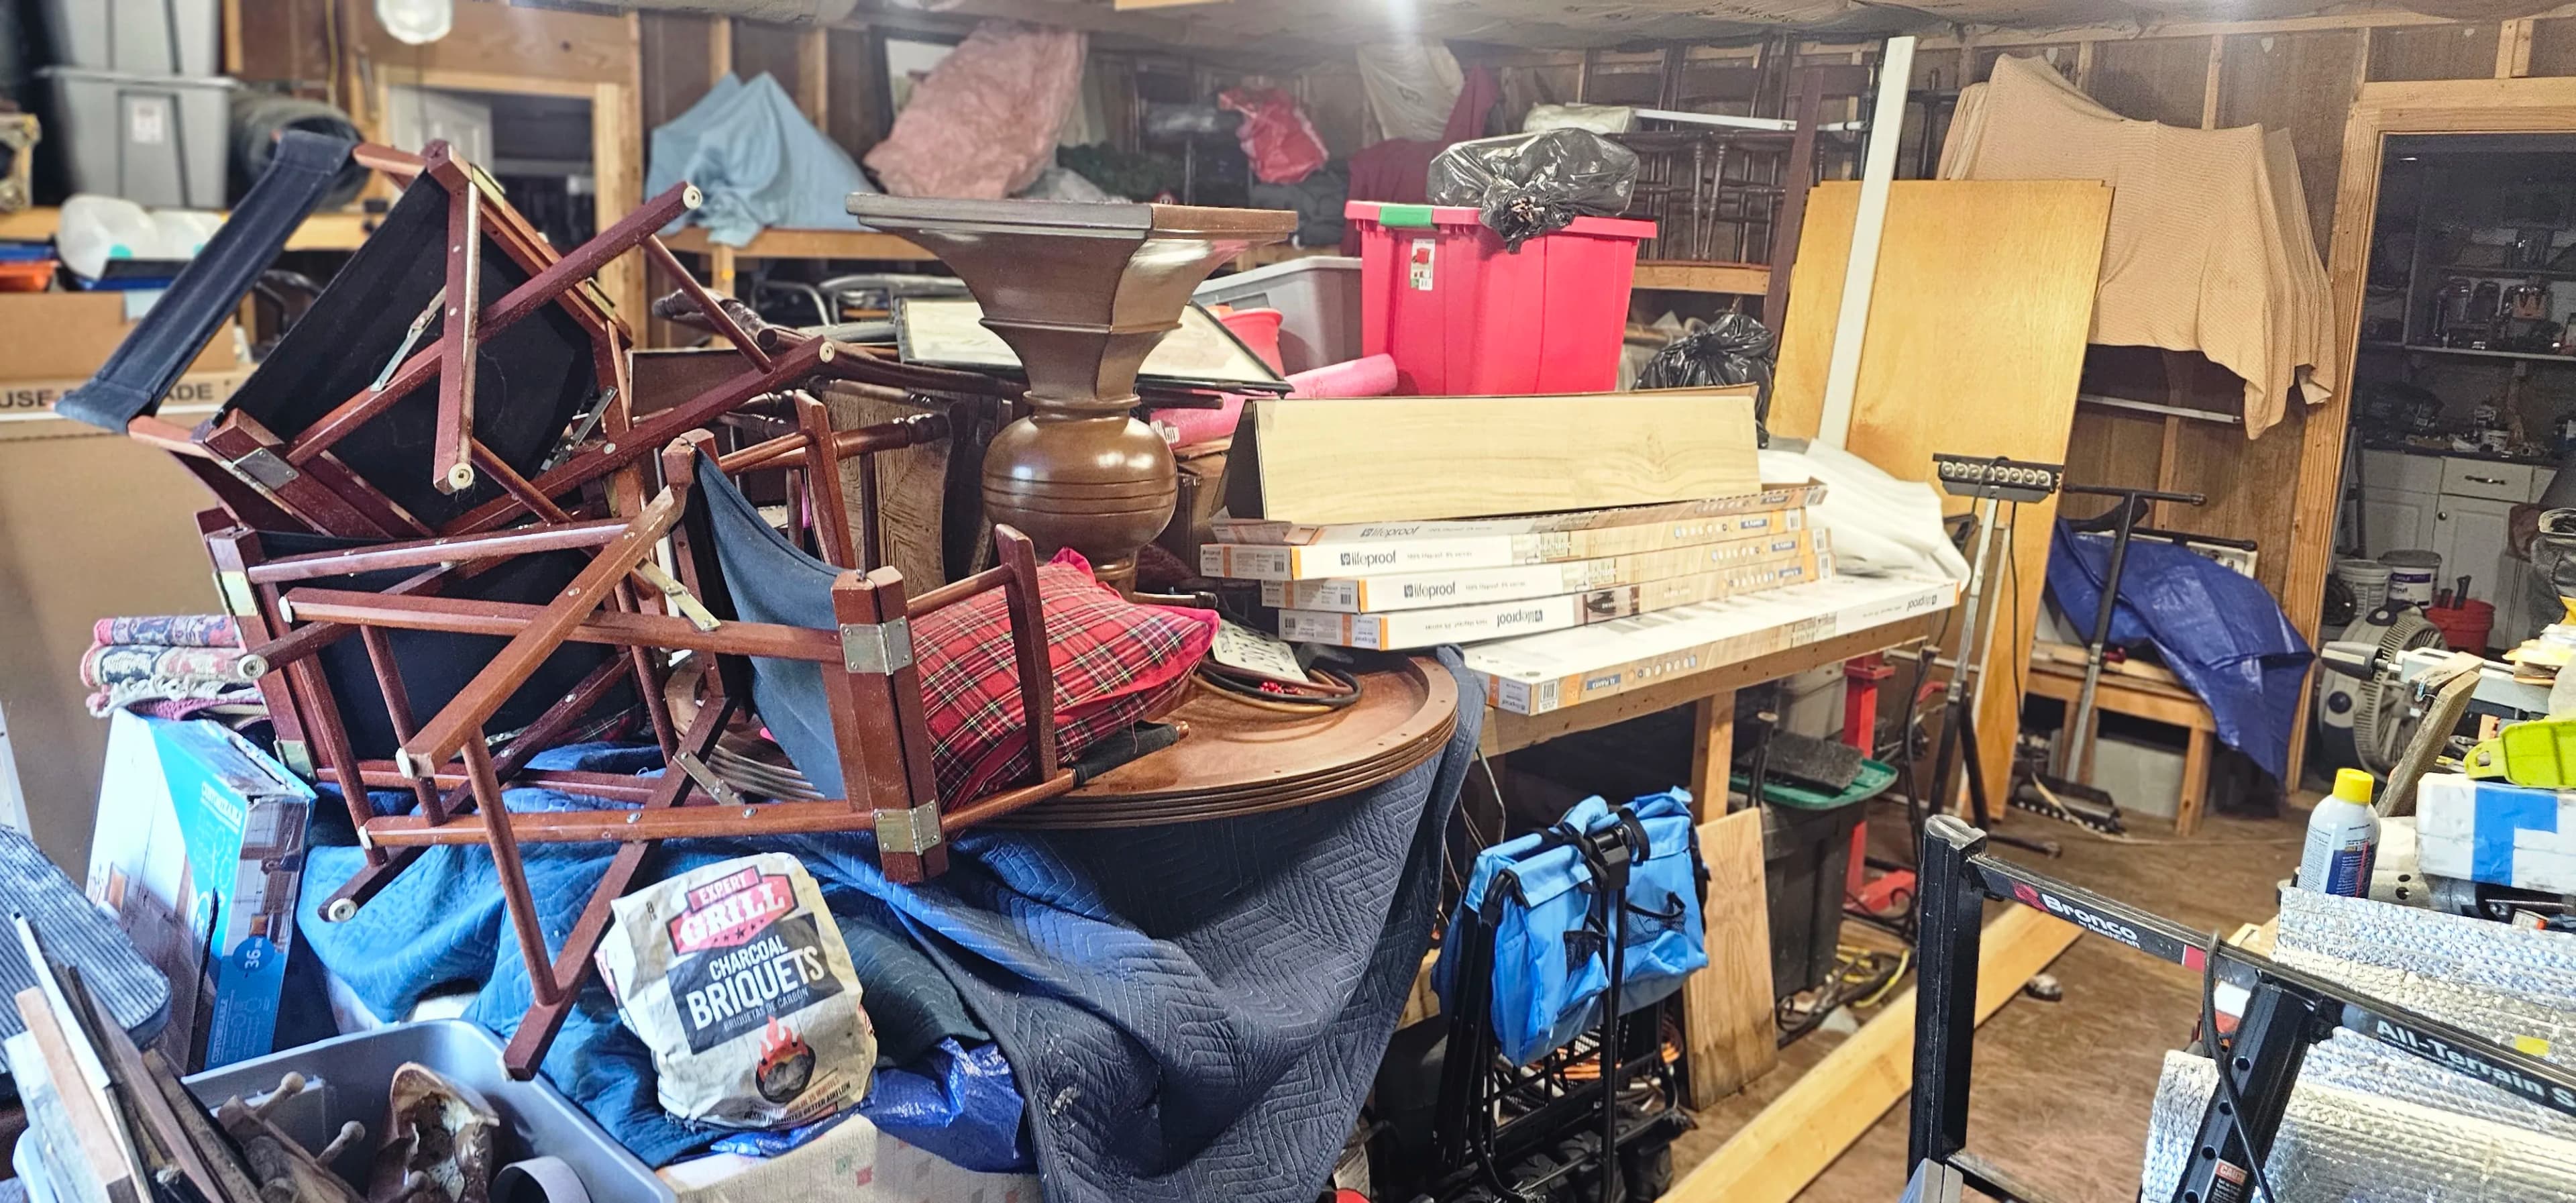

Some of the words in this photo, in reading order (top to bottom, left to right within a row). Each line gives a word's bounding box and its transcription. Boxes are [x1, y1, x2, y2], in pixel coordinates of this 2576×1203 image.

[1351, 550, 1396, 568] lifeproof
[1415, 581, 1455, 600] lifeproof
[697, 874, 747, 904] EXPERT
[680, 883, 785, 947] GRILL
[2041, 893, 2137, 940] Bronco
[244, 949, 261, 970] 36
[709, 935, 788, 981] CHARCOAL
[686, 945, 824, 1031] BRIQUETS
[766, 1002, 776, 1013] DE
[2376, 1020, 2545, 1096] All-Terrain
